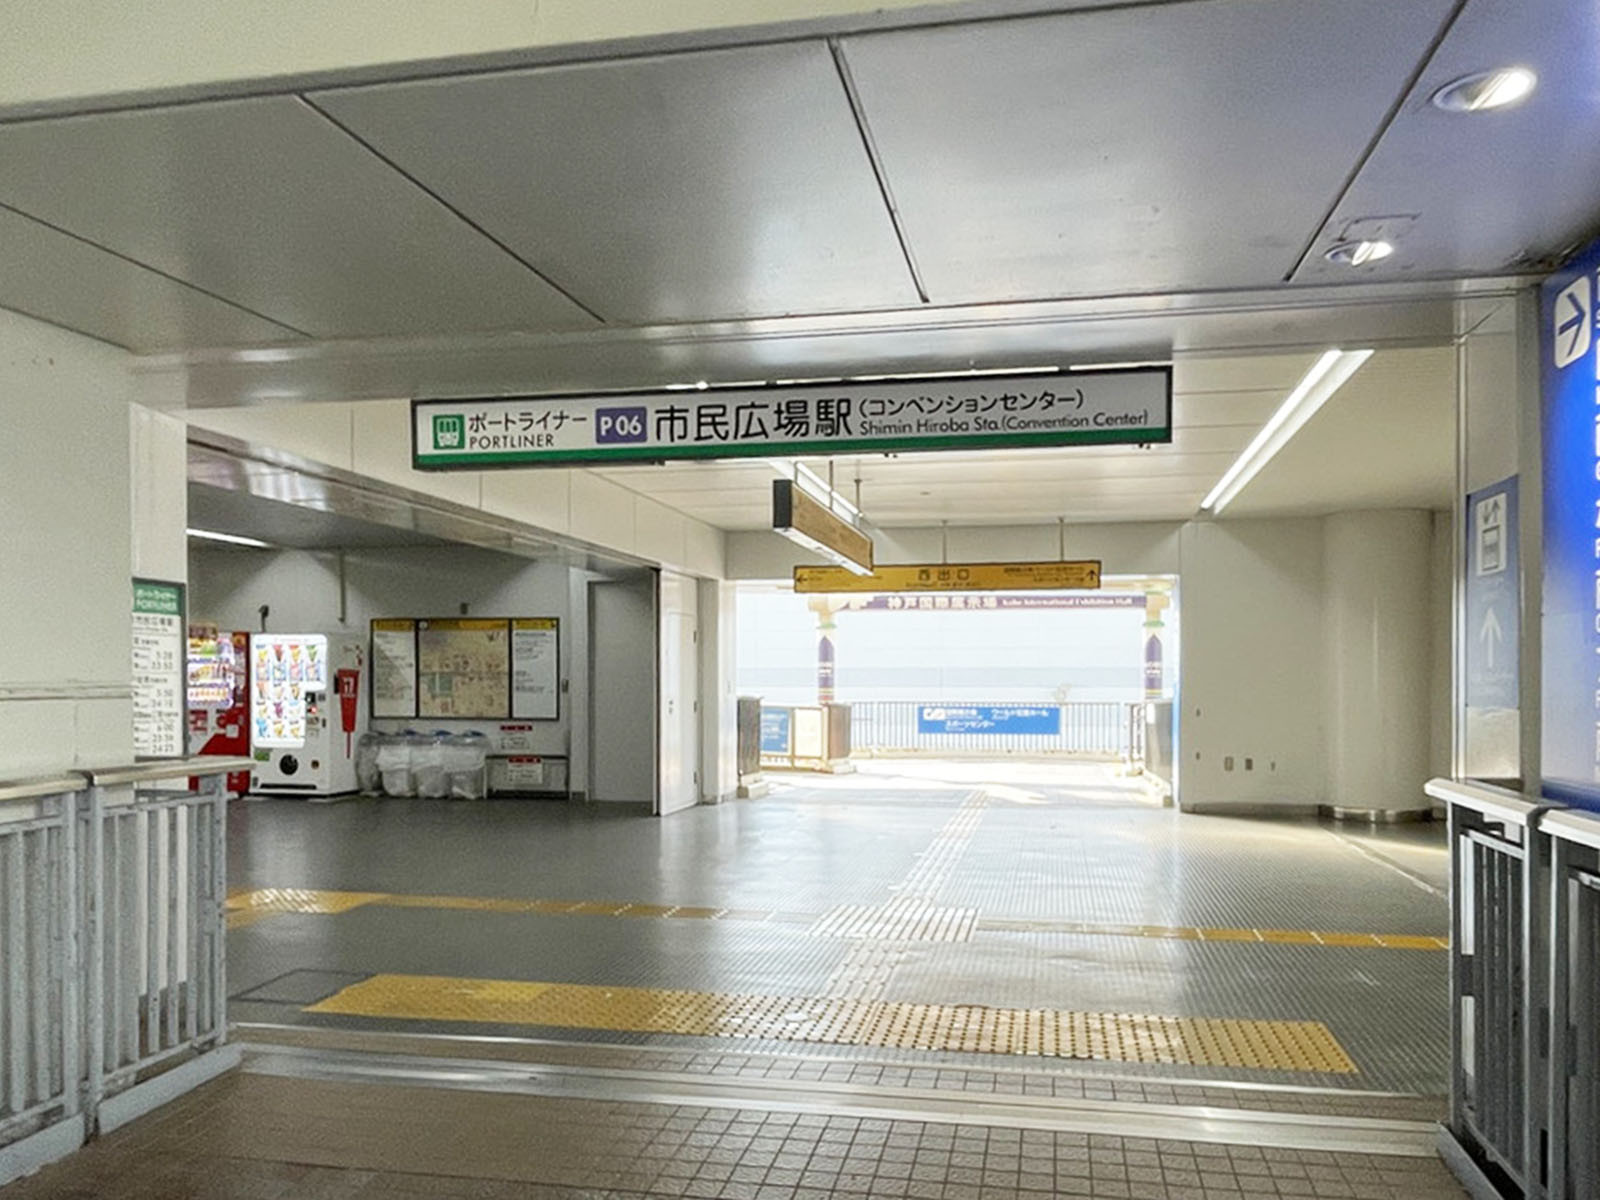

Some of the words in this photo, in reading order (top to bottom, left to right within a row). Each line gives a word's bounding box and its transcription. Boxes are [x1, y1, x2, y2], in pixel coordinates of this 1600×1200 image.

[469, 411, 587, 432] ポートライナー
[655, 398, 852, 442] 市民広場駅
[860, 420, 912, 436] Shimin
[916, 417, 969, 433] Hiroba
[469, 434, 554, 449] PORTLINER
